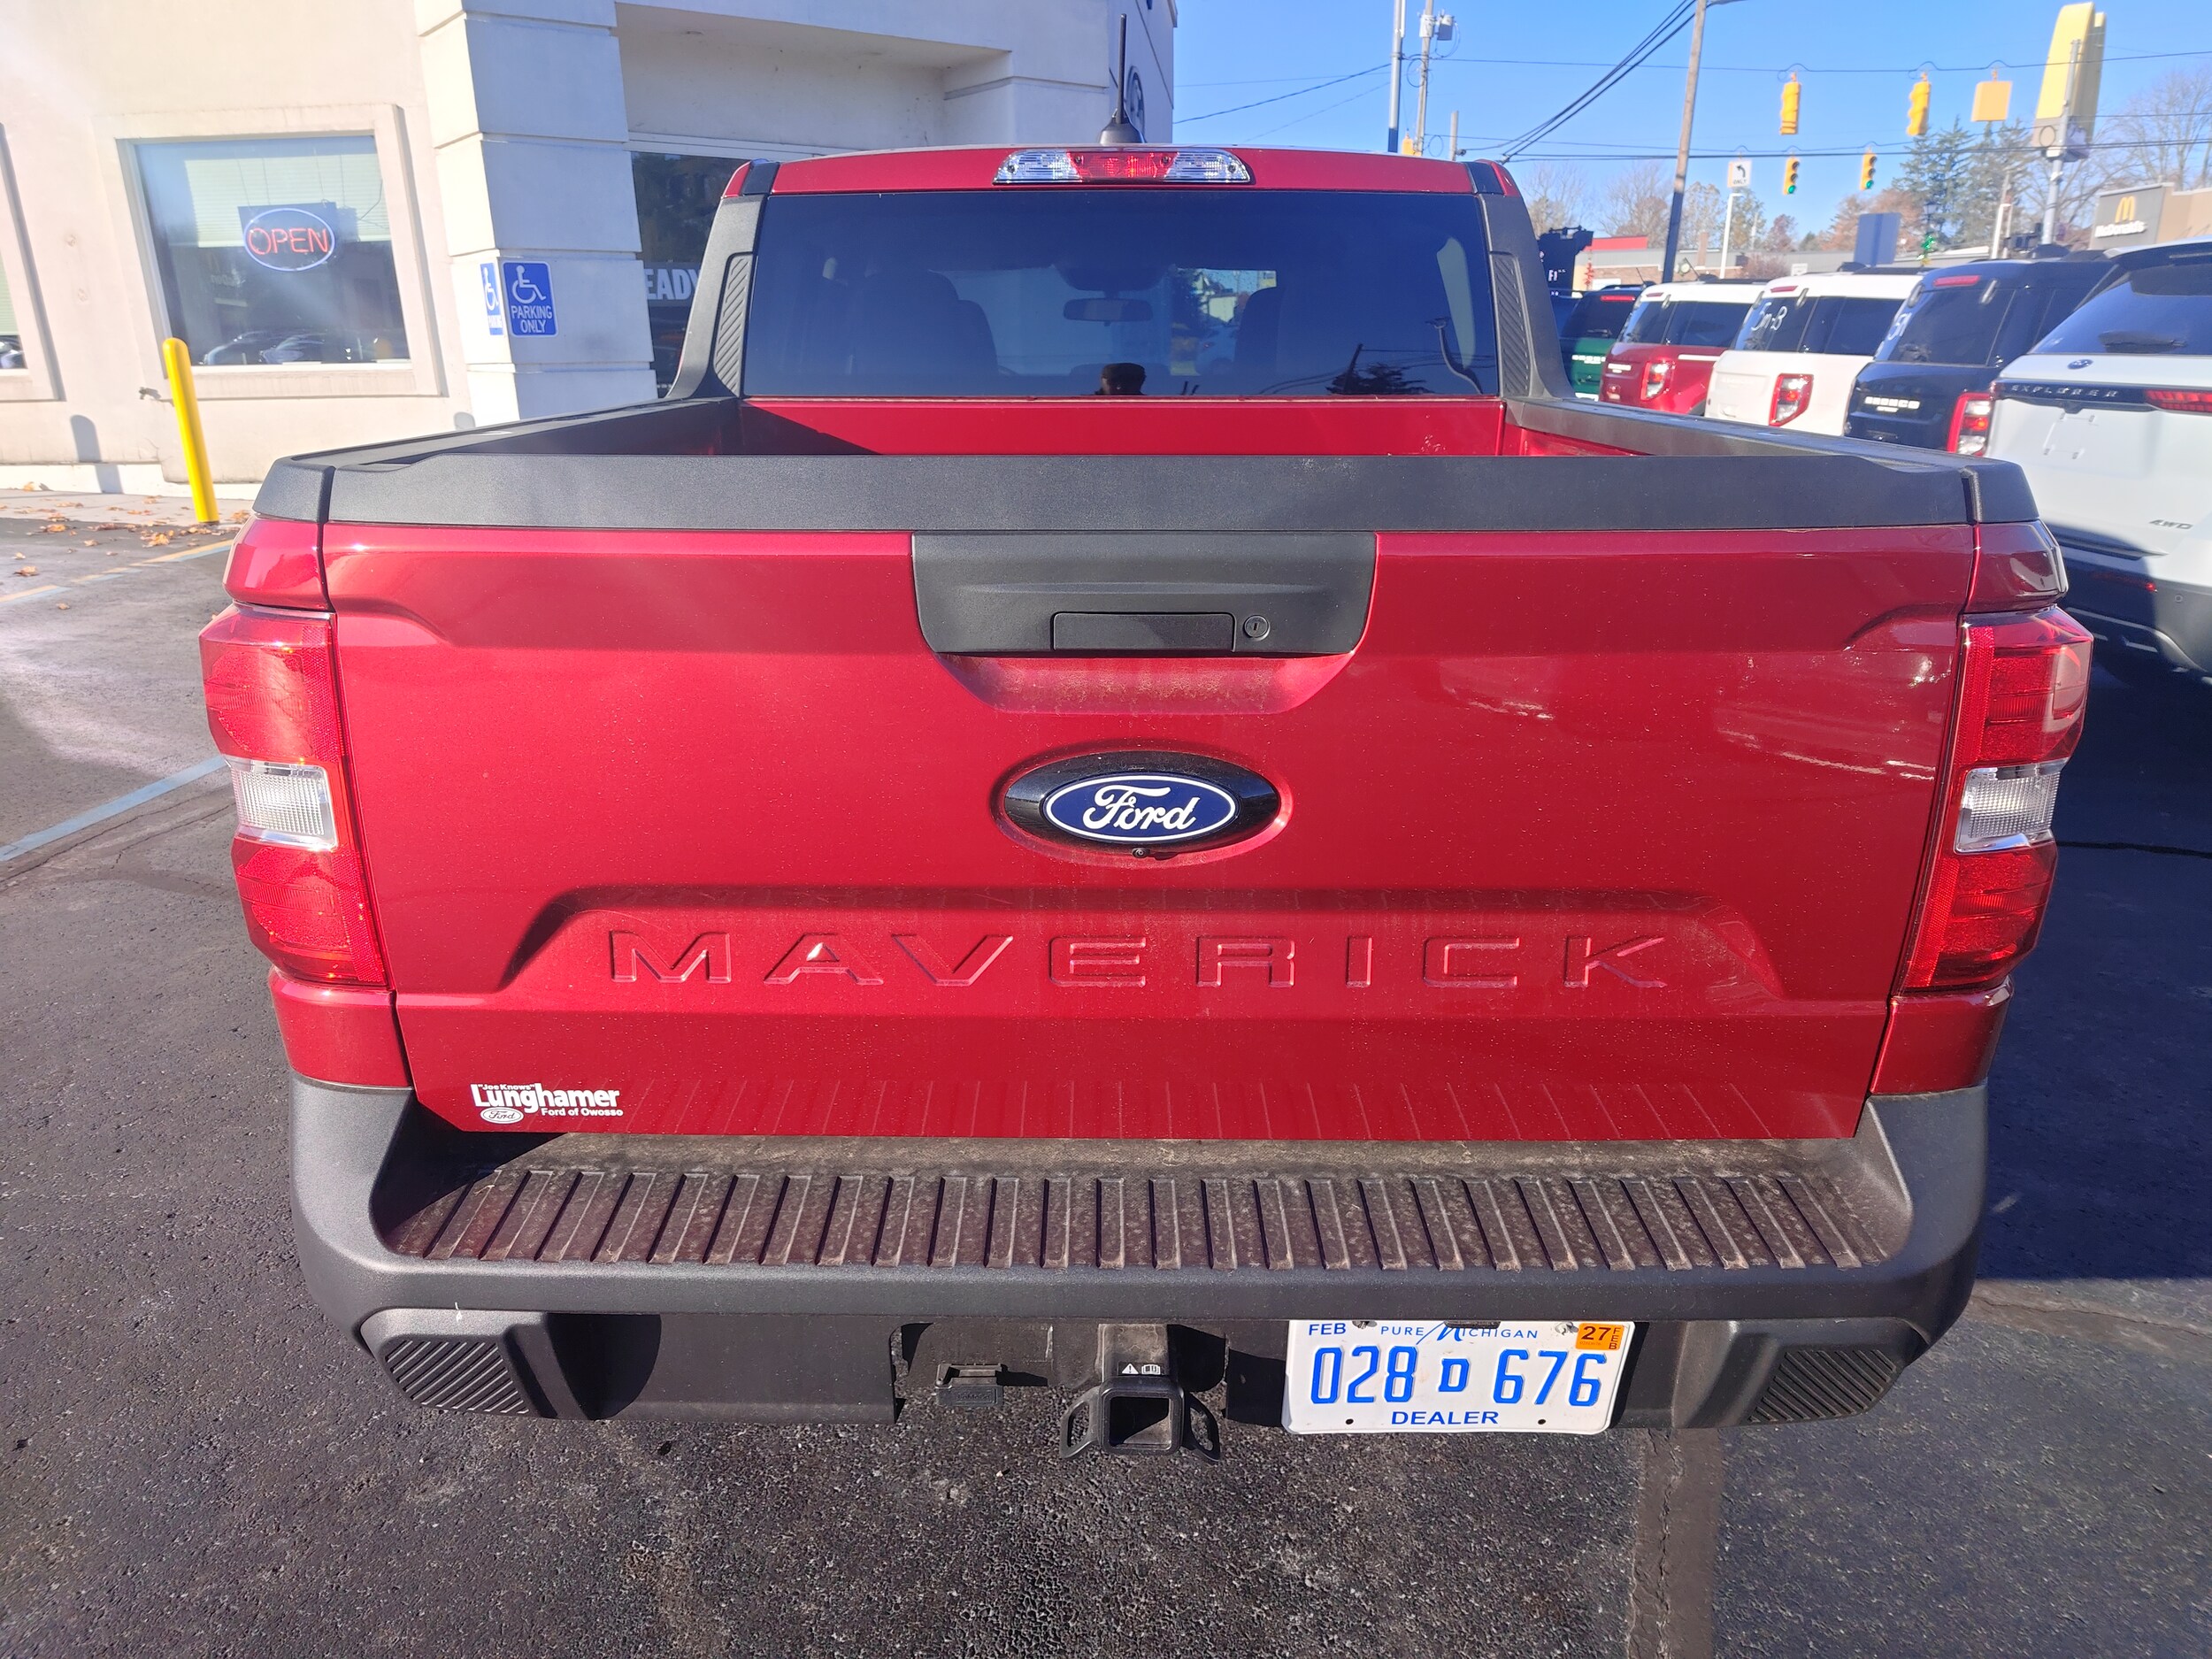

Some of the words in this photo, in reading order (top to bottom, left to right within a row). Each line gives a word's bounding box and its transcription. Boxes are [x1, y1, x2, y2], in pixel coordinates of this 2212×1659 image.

[248, 227, 329, 255] OPEN
[511, 305, 553, 319] PARKING
[520, 319, 547, 334] ONLY
[2011, 385, 2118, 398] EXPLORER
[1082, 784, 1201, 831] Ford
[610, 930, 1666, 988] MAVERICK
[470, 1083, 620, 1113] Lunghamer
[488, 1110, 516, 1119] Ford
[580, 1108, 624, 1117] Owosso
[1309, 1323, 1347, 1335] FEB
[1380, 1326, 1424, 1336] PURE
[1581, 1326, 1611, 1340] 27
[1310, 1346, 1417, 1404] 028
[1438, 1358, 1470, 1392] D
[1493, 1348, 1608, 1406] 676
[1391, 1410, 1499, 1425] DEALER
